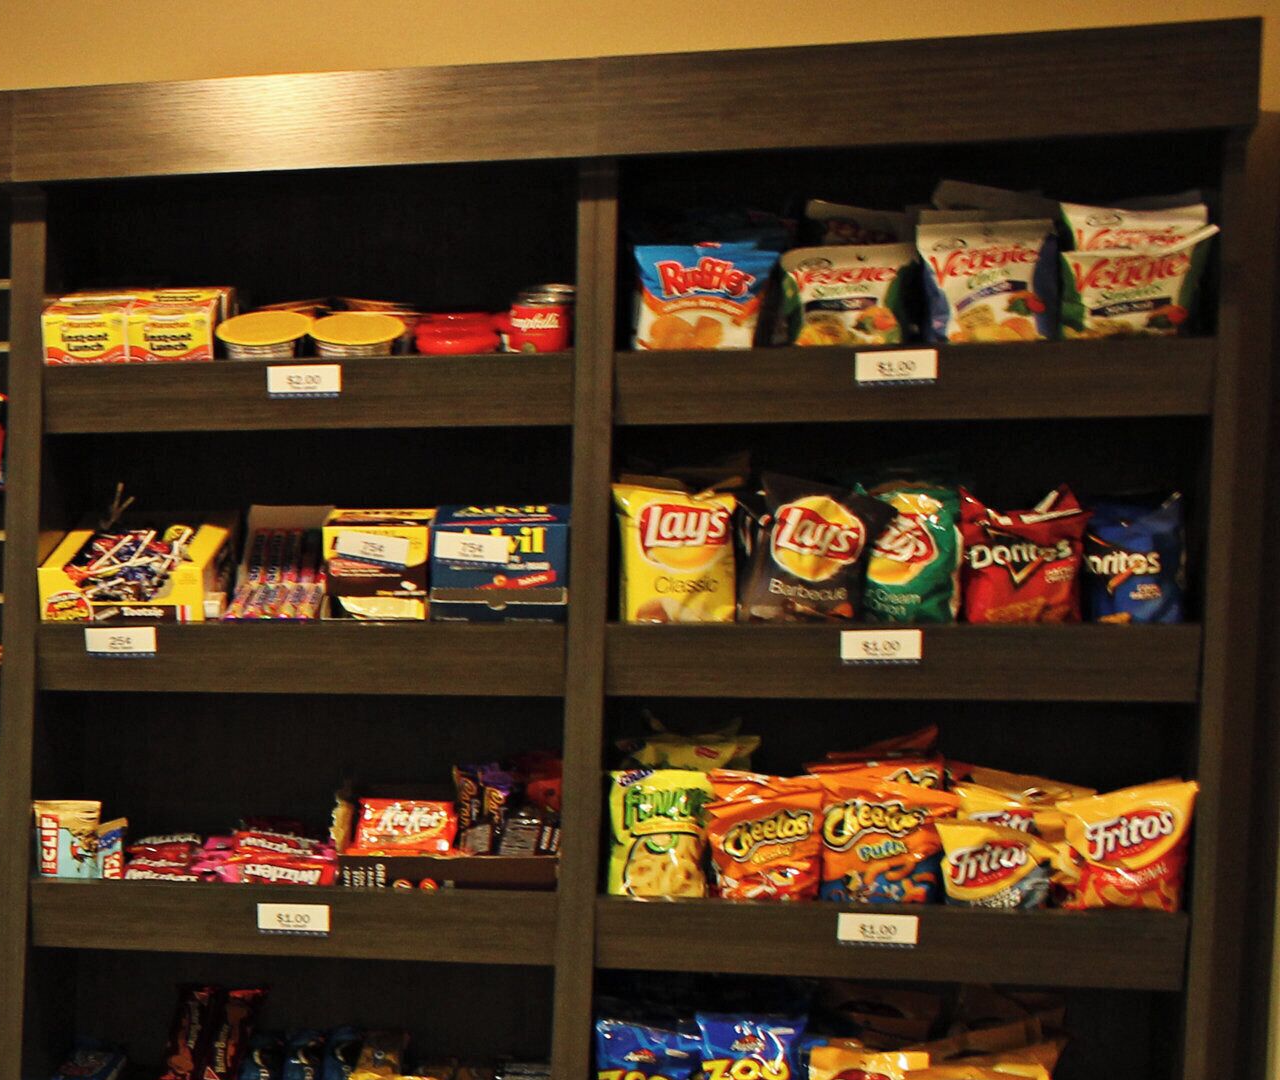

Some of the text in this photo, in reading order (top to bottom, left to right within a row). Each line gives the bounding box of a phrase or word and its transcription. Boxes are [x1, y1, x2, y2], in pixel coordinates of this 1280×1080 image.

[655, 255, 758, 298] Ruffles
[645, 504, 729, 548] Lay's
[775, 503, 858, 559] Lay's
[971, 541, 1074, 571] Doritos
[653, 575, 721, 595] Classic
[768, 578, 849, 600] Barbecue
[722, 811, 814, 862] Cheetos
[1088, 810, 1175, 862] Fritos
[275, 913, 311, 924] $1.00
[858, 923, 899, 937] $1.00
